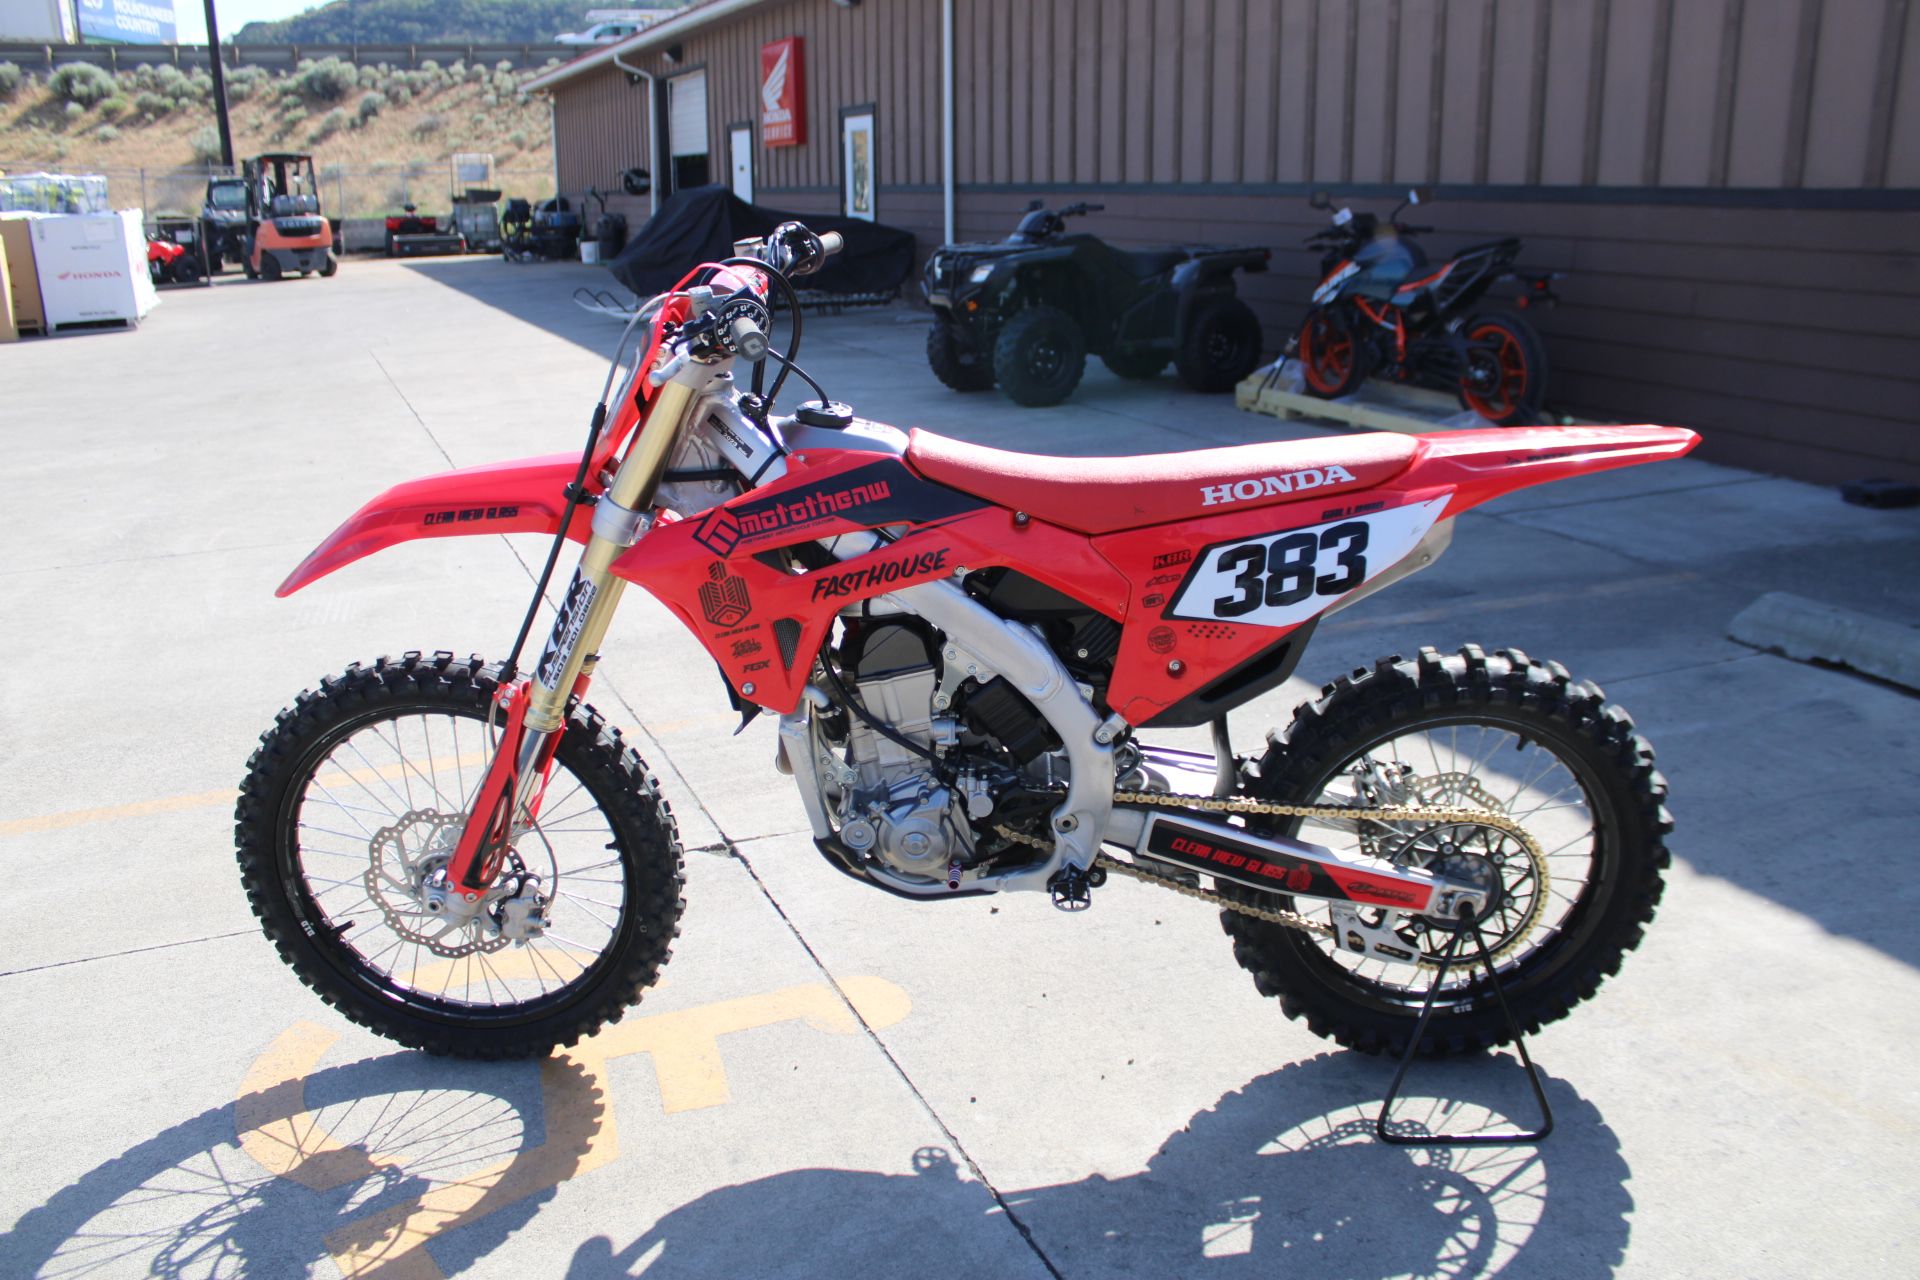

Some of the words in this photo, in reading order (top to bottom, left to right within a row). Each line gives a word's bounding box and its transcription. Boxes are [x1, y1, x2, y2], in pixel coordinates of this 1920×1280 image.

[763, 109, 792, 125] HONDA
[73, 271, 122, 281] HONDA
[1200, 465, 1356, 506] HONDA
[811, 548, 950, 602] FASTHOUSE
[1214, 521, 1369, 617] 383
[1171, 837, 1211, 859] CLEAR
[1212, 848, 1246, 870] VIEW
[1248, 858, 1287, 880] GLASS
